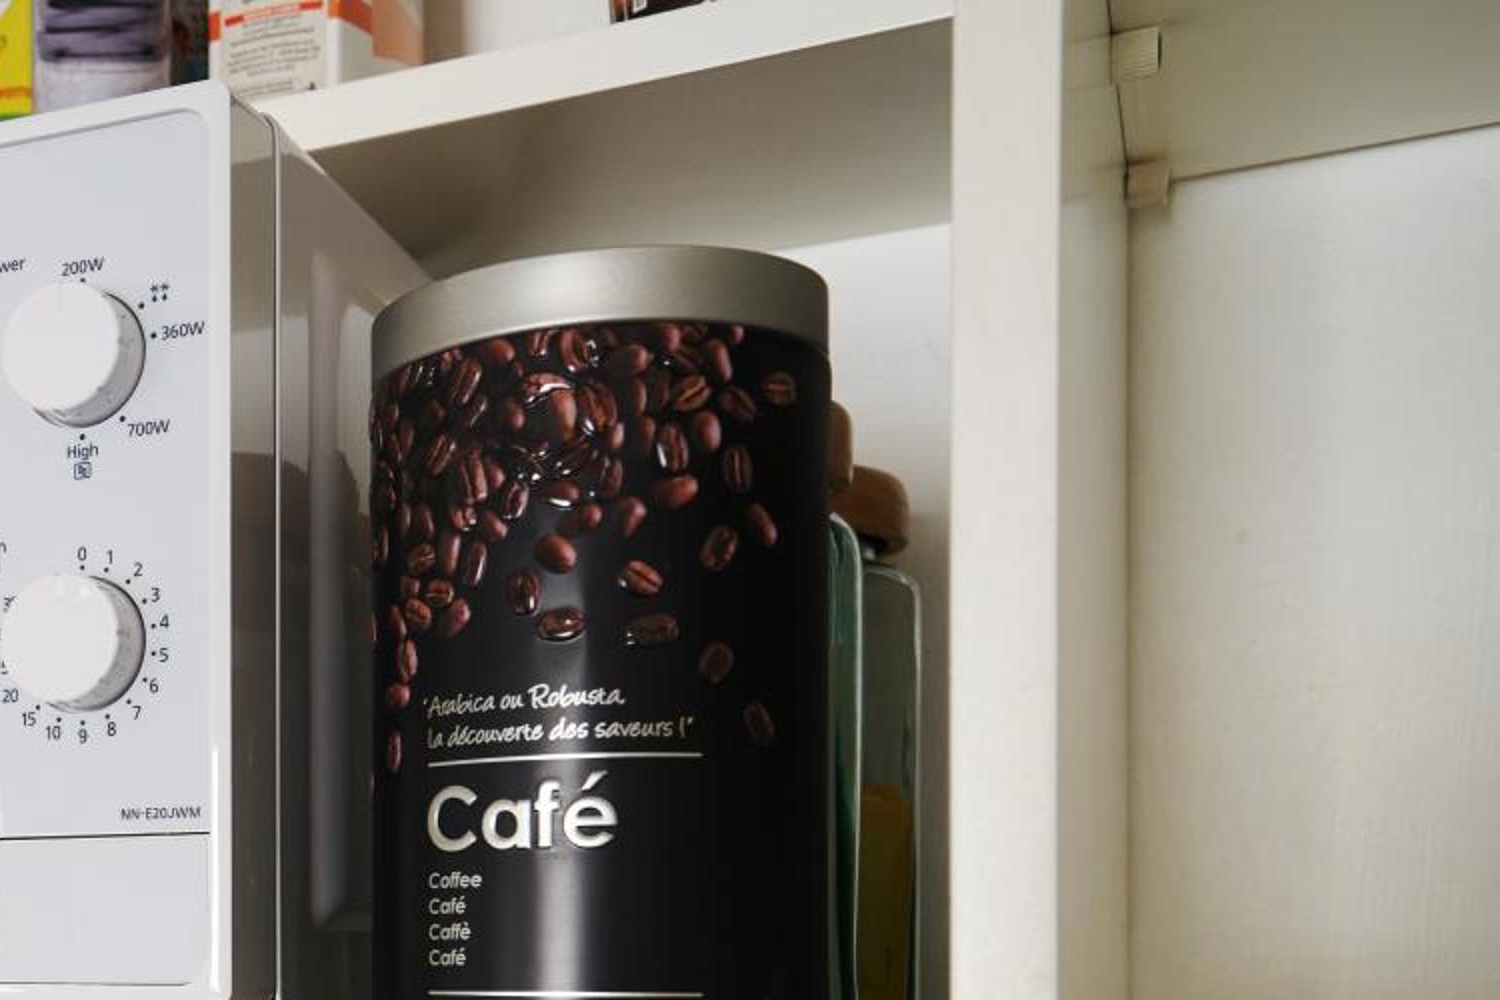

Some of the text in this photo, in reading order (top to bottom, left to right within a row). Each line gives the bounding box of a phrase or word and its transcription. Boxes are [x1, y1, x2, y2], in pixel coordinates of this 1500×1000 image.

[61, 257, 105, 277] 200W
[161, 321, 205, 341] 360W
[127, 419, 171, 437] 700W
[67, 442, 99, 461] High
[77, 546, 87, 562] 0
[106, 549, 113, 565] 1
[133, 561, 143, 577] 2
[151, 587, 161, 603] 3
[159, 614, 170, 629] 4
[159, 647, 169, 663] 5
[149, 680, 159, 694] 6
[2, 687, 19, 704] 20
[500, 694, 524, 710] ou
[21, 711, 37, 727] 15
[131, 705, 142, 721] 7
[45, 725, 62, 740] 10
[77, 727, 89, 745] 9
[107, 721, 117, 737] 8
[426, 727, 445, 749] la
[447, 723, 545, 746] découverte
[549, 717, 589, 740] des
[593, 720, 675, 739] saveurs
[120, 805, 203, 821] NN-E20JWM
[427, 770, 618, 852] Café
[429, 871, 483, 889] Coffee
[429, 895, 467, 915] Café
[429, 921, 472, 941] Caffè
[429, 947, 467, 966] Café
